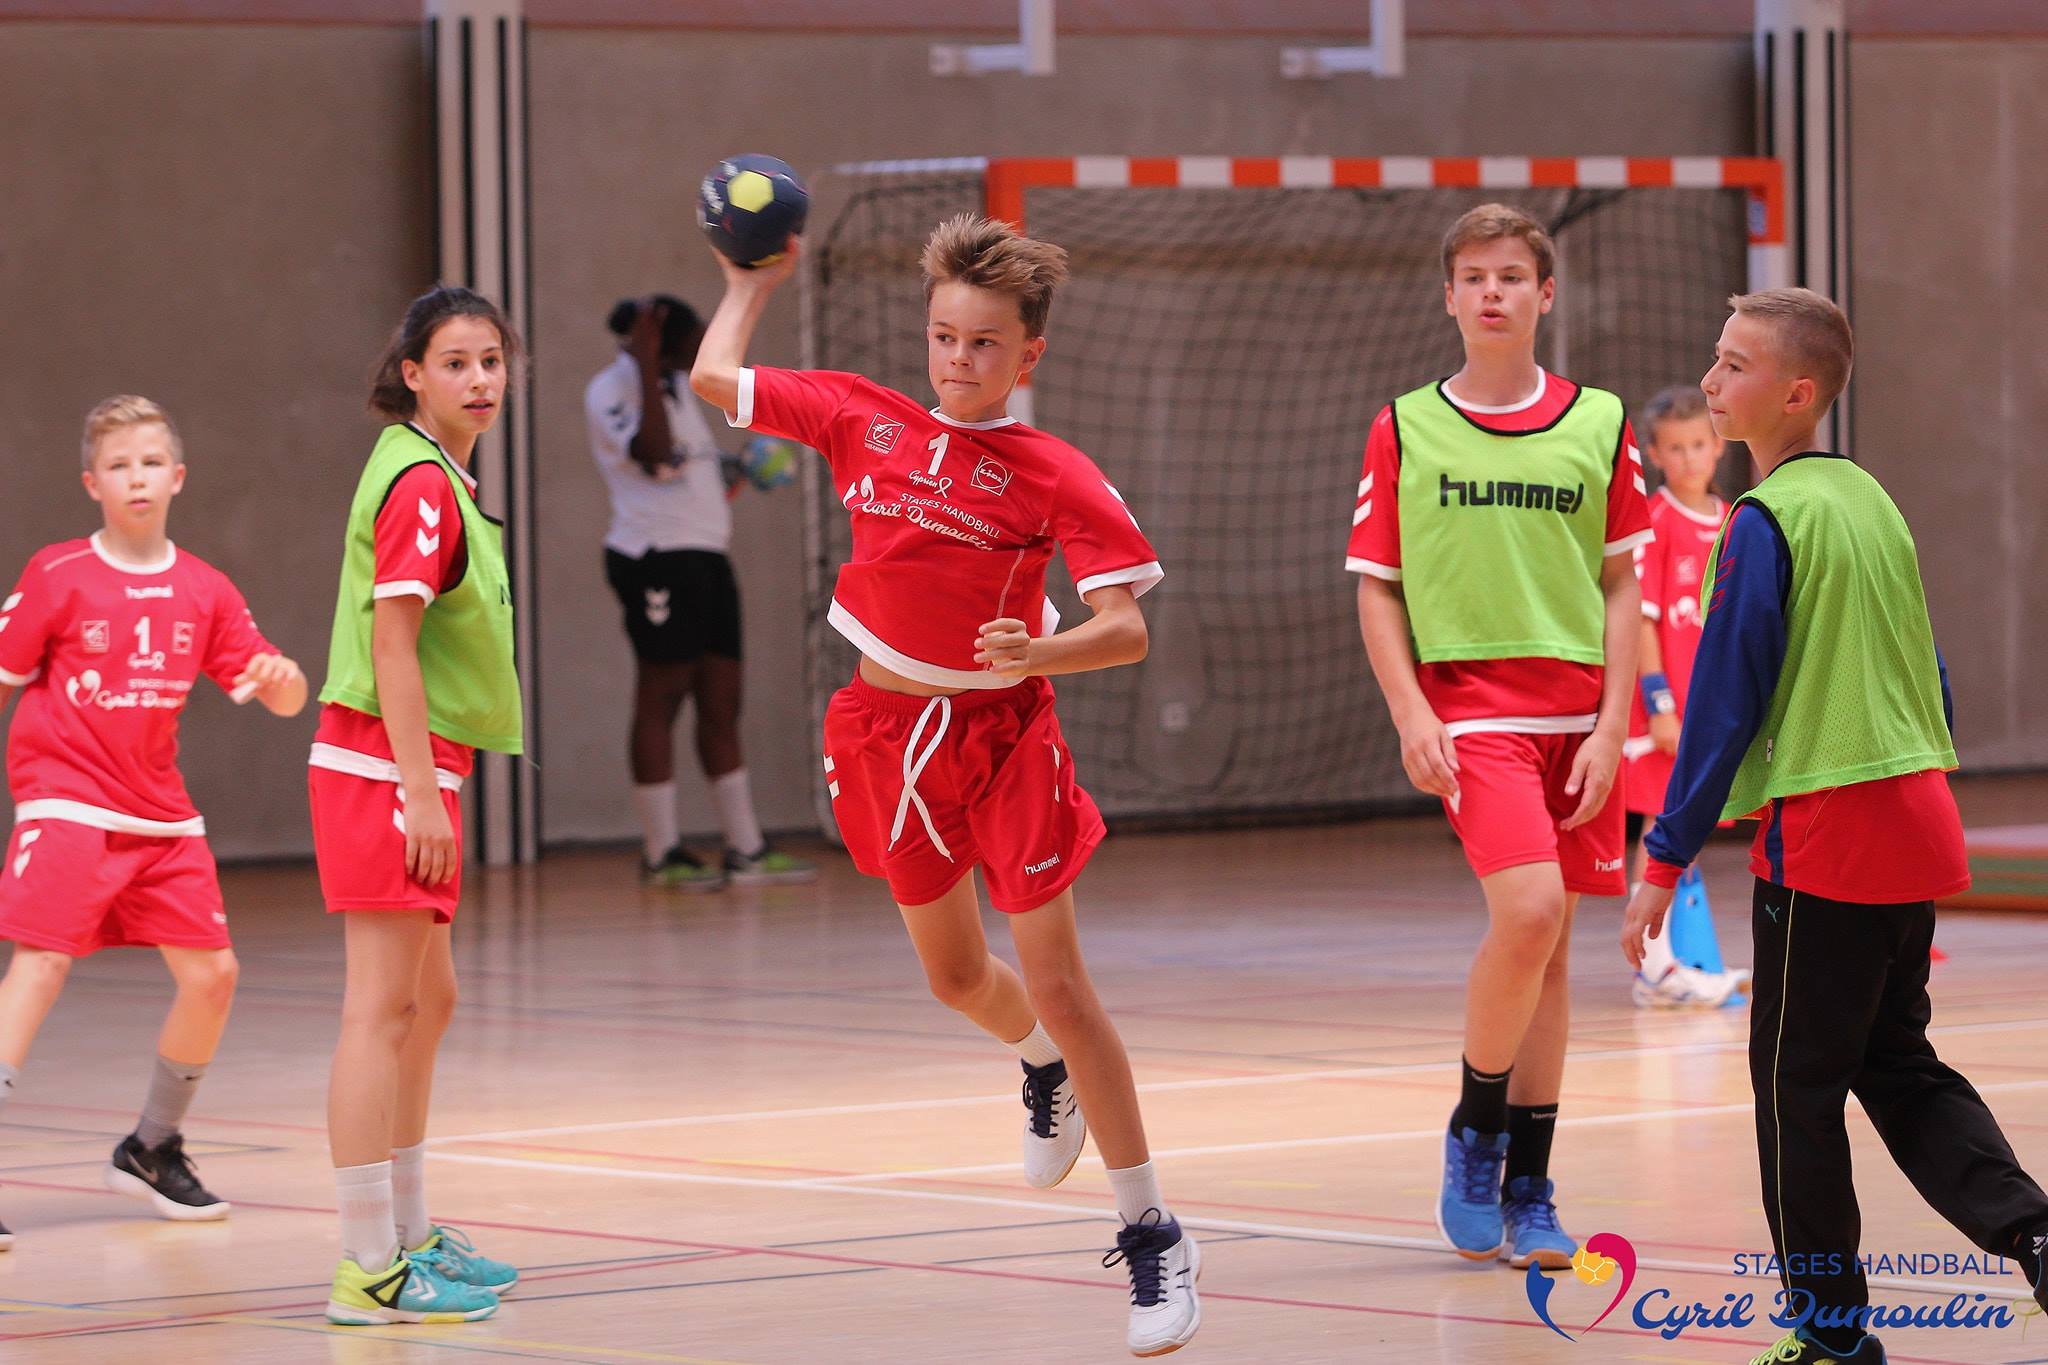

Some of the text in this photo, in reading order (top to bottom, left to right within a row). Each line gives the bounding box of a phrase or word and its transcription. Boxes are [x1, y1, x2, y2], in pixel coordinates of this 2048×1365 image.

[928, 432, 950, 476] 1
[908, 469, 938, 488] Cyprien
[1440, 473, 1584, 514] hummel
[900, 492, 1000, 539] STAGES HANDBALL
[134, 616, 150, 655] 1
[1024, 853, 1060, 876] hummel
